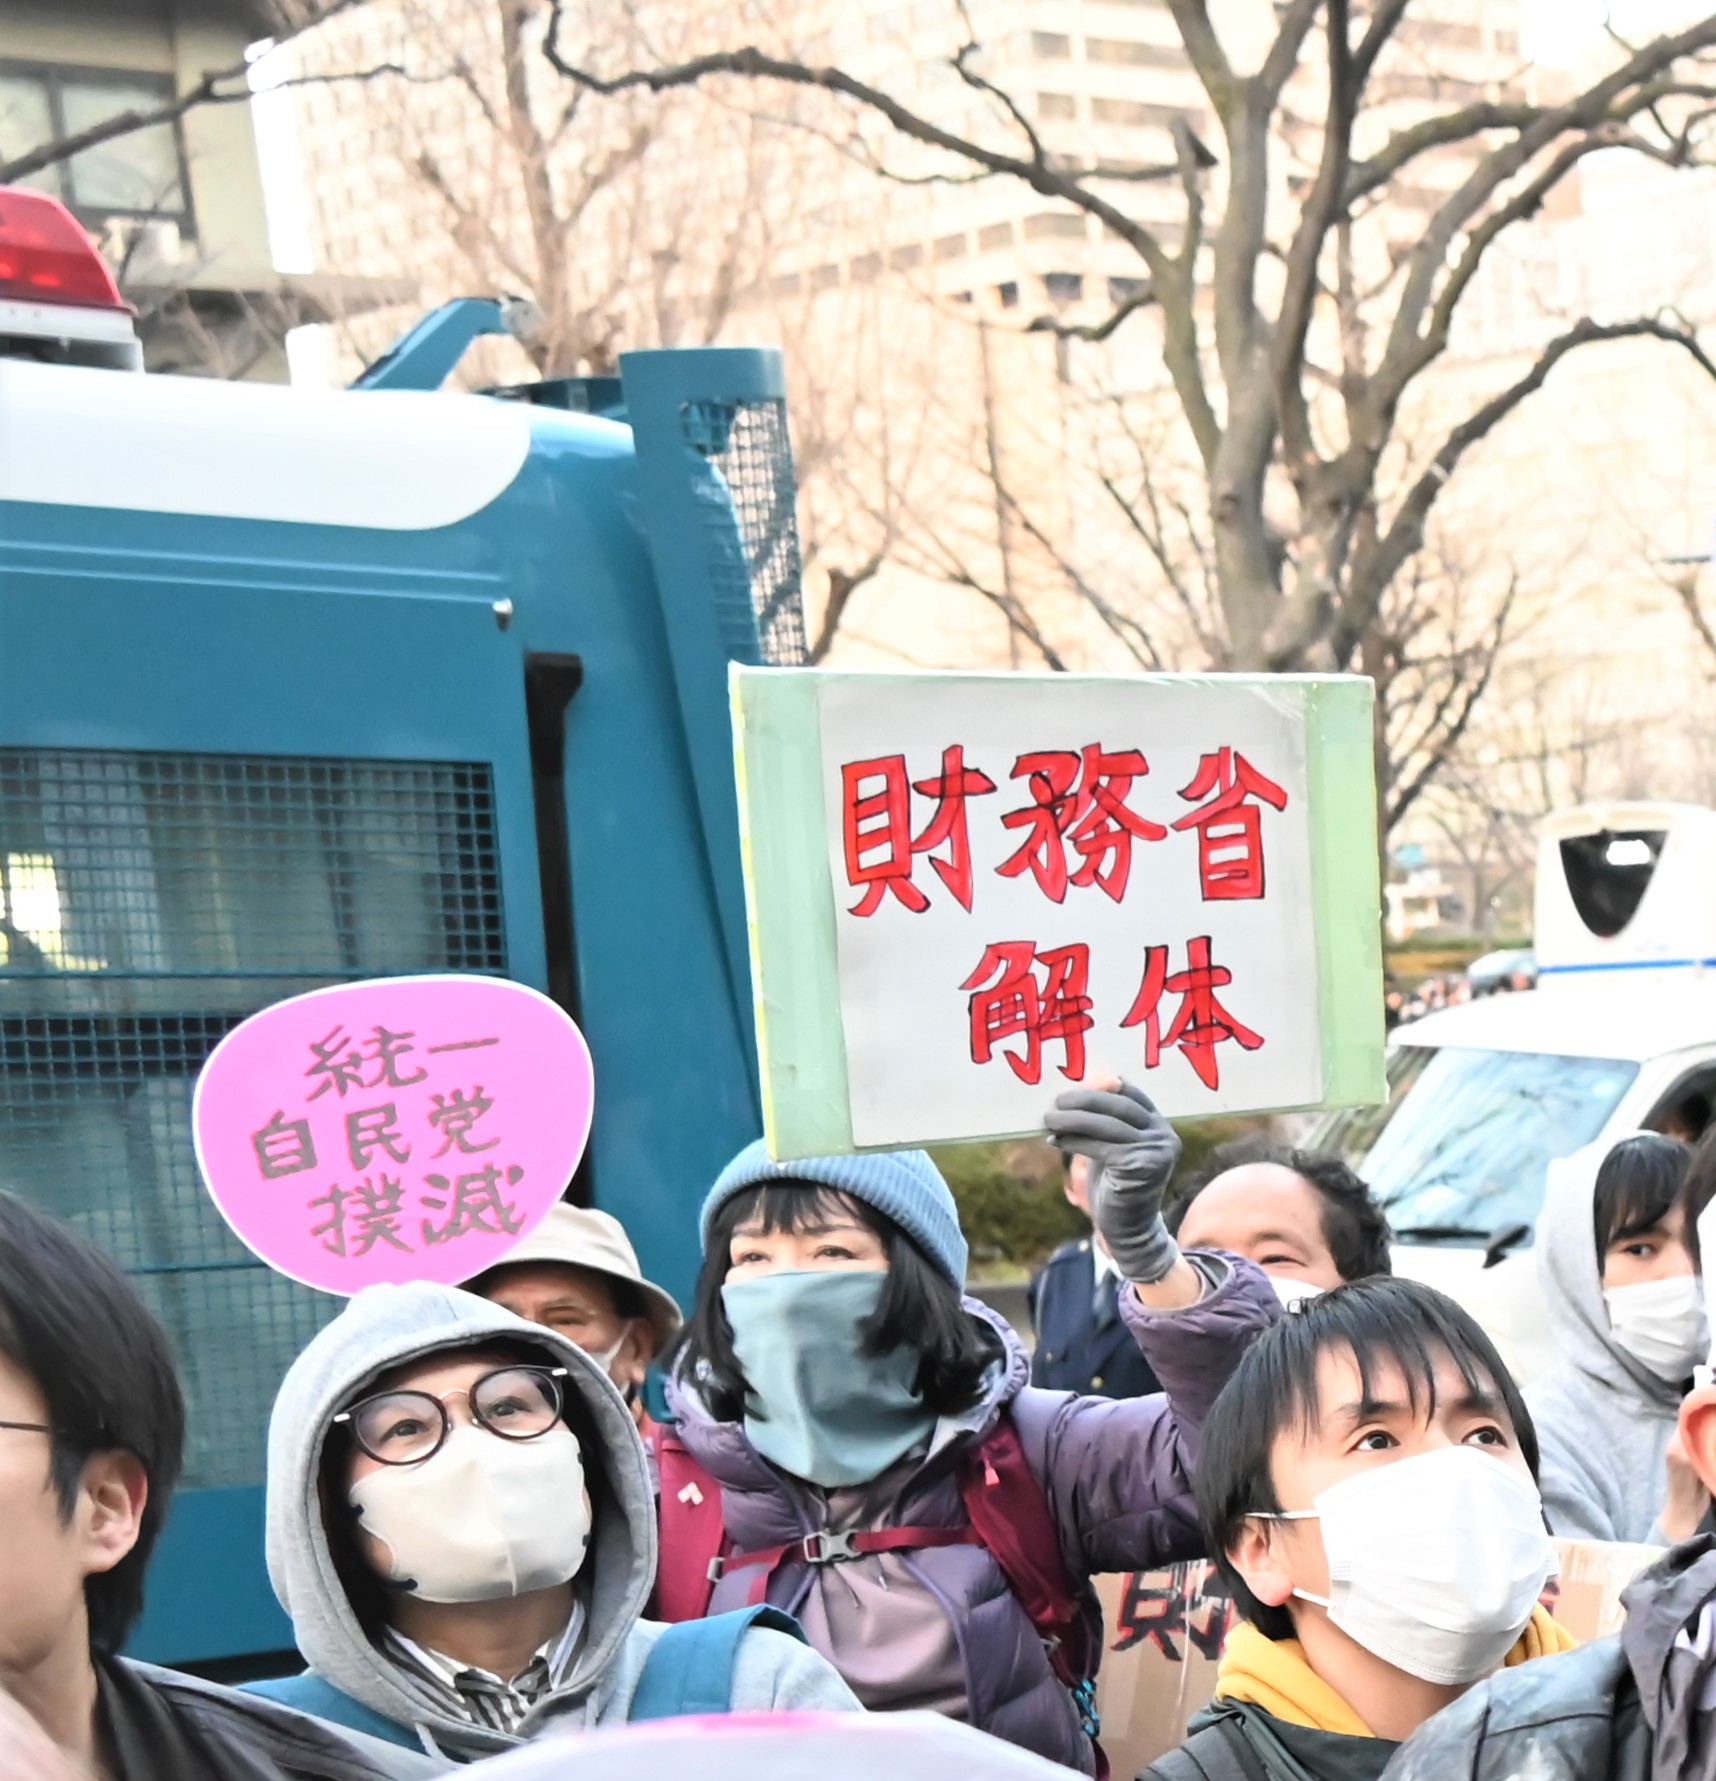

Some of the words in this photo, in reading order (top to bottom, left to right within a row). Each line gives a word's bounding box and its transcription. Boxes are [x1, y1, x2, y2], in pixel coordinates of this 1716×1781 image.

[840, 742, 1290, 918] 財務省
[957, 934, 1266, 1091] 解体
[303, 1025, 501, 1101] 統一
[251, 1085, 502, 1180] 自民党
[307, 1162, 527, 1258] 撲滅
